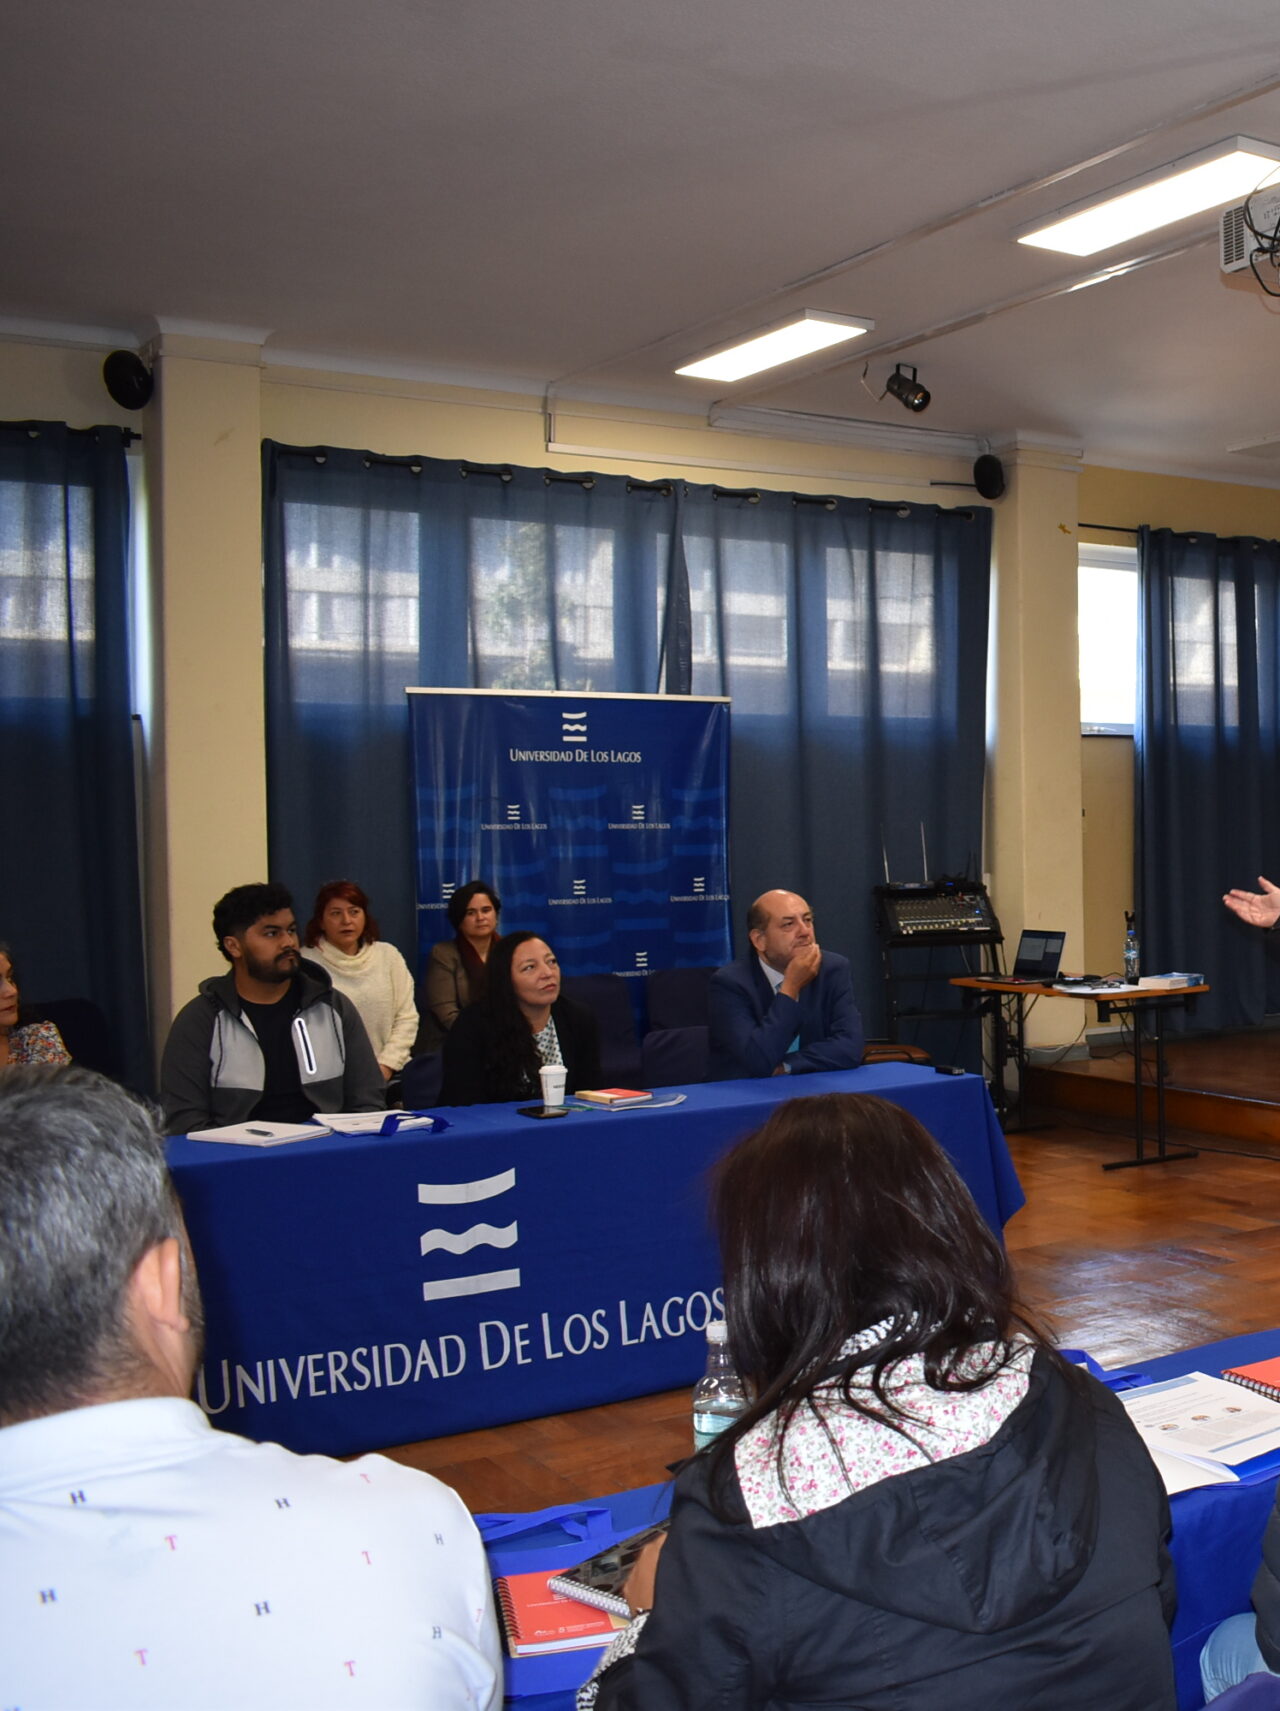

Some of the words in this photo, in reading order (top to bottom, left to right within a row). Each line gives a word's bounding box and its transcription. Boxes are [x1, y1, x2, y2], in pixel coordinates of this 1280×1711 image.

[509, 748, 573, 762] UNIVERSIDAD
[575, 749, 589, 762] DE
[591, 750, 609, 763] LOS
[610, 750, 642, 763] LAGOS
[198, 1335, 466, 1415] UNIVERSIDAD
[479, 1320, 532, 1371] DE
[541, 1309, 610, 1360] LOS
[619, 1287, 726, 1346] LAGOS
[70, 1490, 86, 1504] H
[275, 1498, 290, 1509] H
[165, 1535, 177, 1550] T
[40, 1589, 56, 1604] H
[254, 1601, 271, 1616] H
[432, 1625, 442, 1639] H
[135, 1649, 147, 1665] T
[344, 1660, 356, 1677] T
